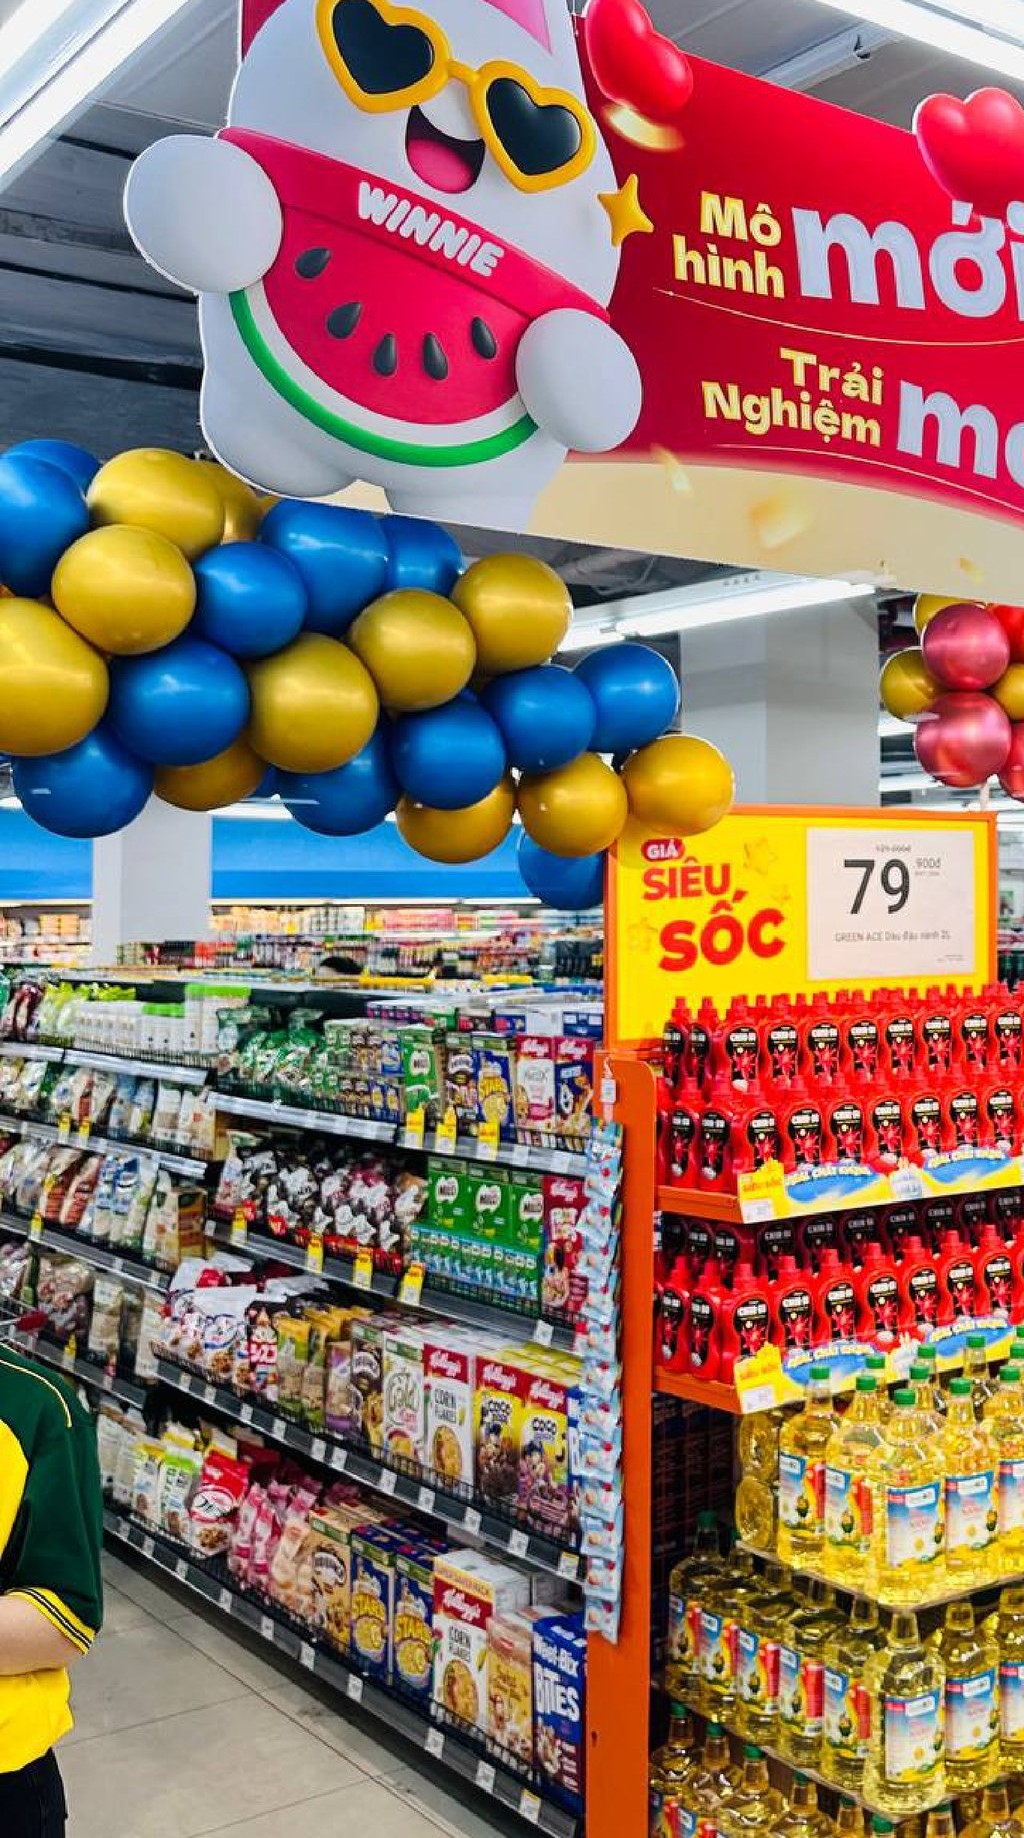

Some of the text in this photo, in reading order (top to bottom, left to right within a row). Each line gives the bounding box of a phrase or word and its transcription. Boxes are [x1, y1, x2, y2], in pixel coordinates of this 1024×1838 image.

[357, 182, 505, 277] WINNIE
[700, 191, 782, 246] Mô
[673, 234, 785, 298] hình
[780, 347, 885, 405] Trải
[702, 381, 881, 444] Nghiệm
[645, 838, 679, 860] GIÁ
[641, 857, 731, 901] SIÊU
[843, 858, 910, 915] 79
[658, 890, 786, 972] SỐC
